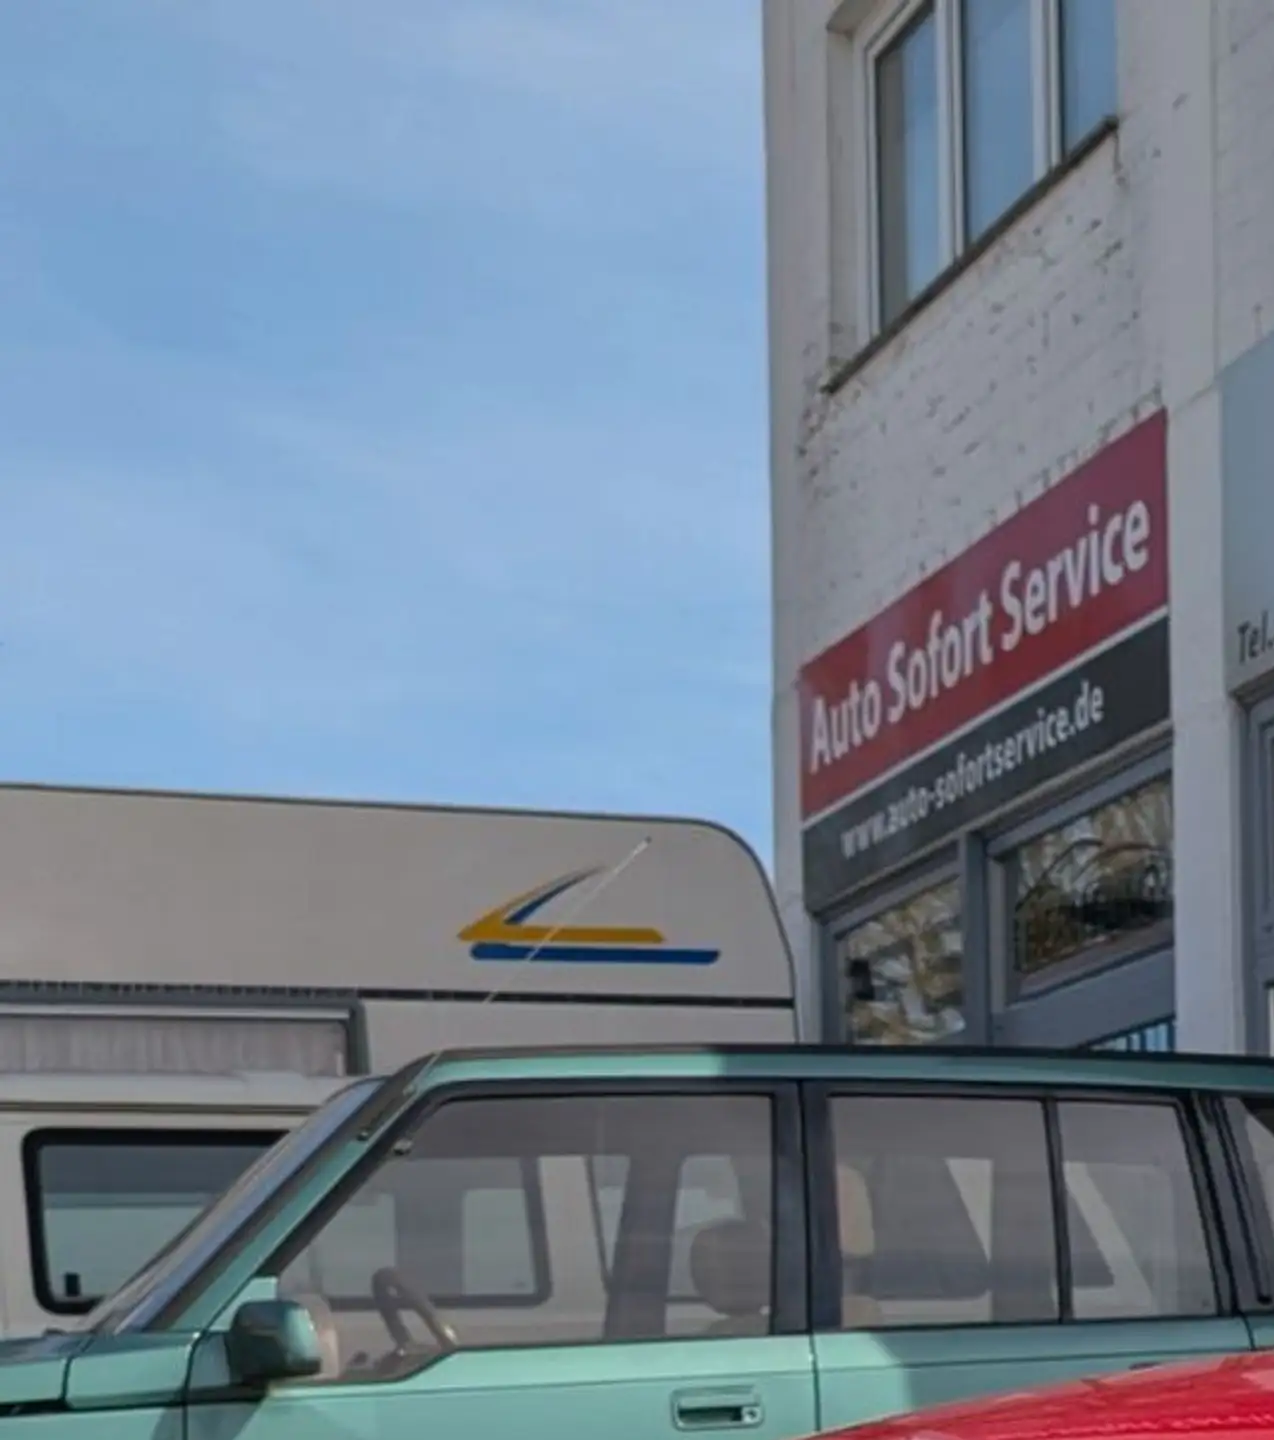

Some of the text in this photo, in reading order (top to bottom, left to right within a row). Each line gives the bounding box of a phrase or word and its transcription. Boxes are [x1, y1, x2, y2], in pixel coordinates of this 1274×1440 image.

[808, 498, 1151, 774] Auto Sofort Service
[840, 679, 1105, 860] www.auto-sofortservice.de
